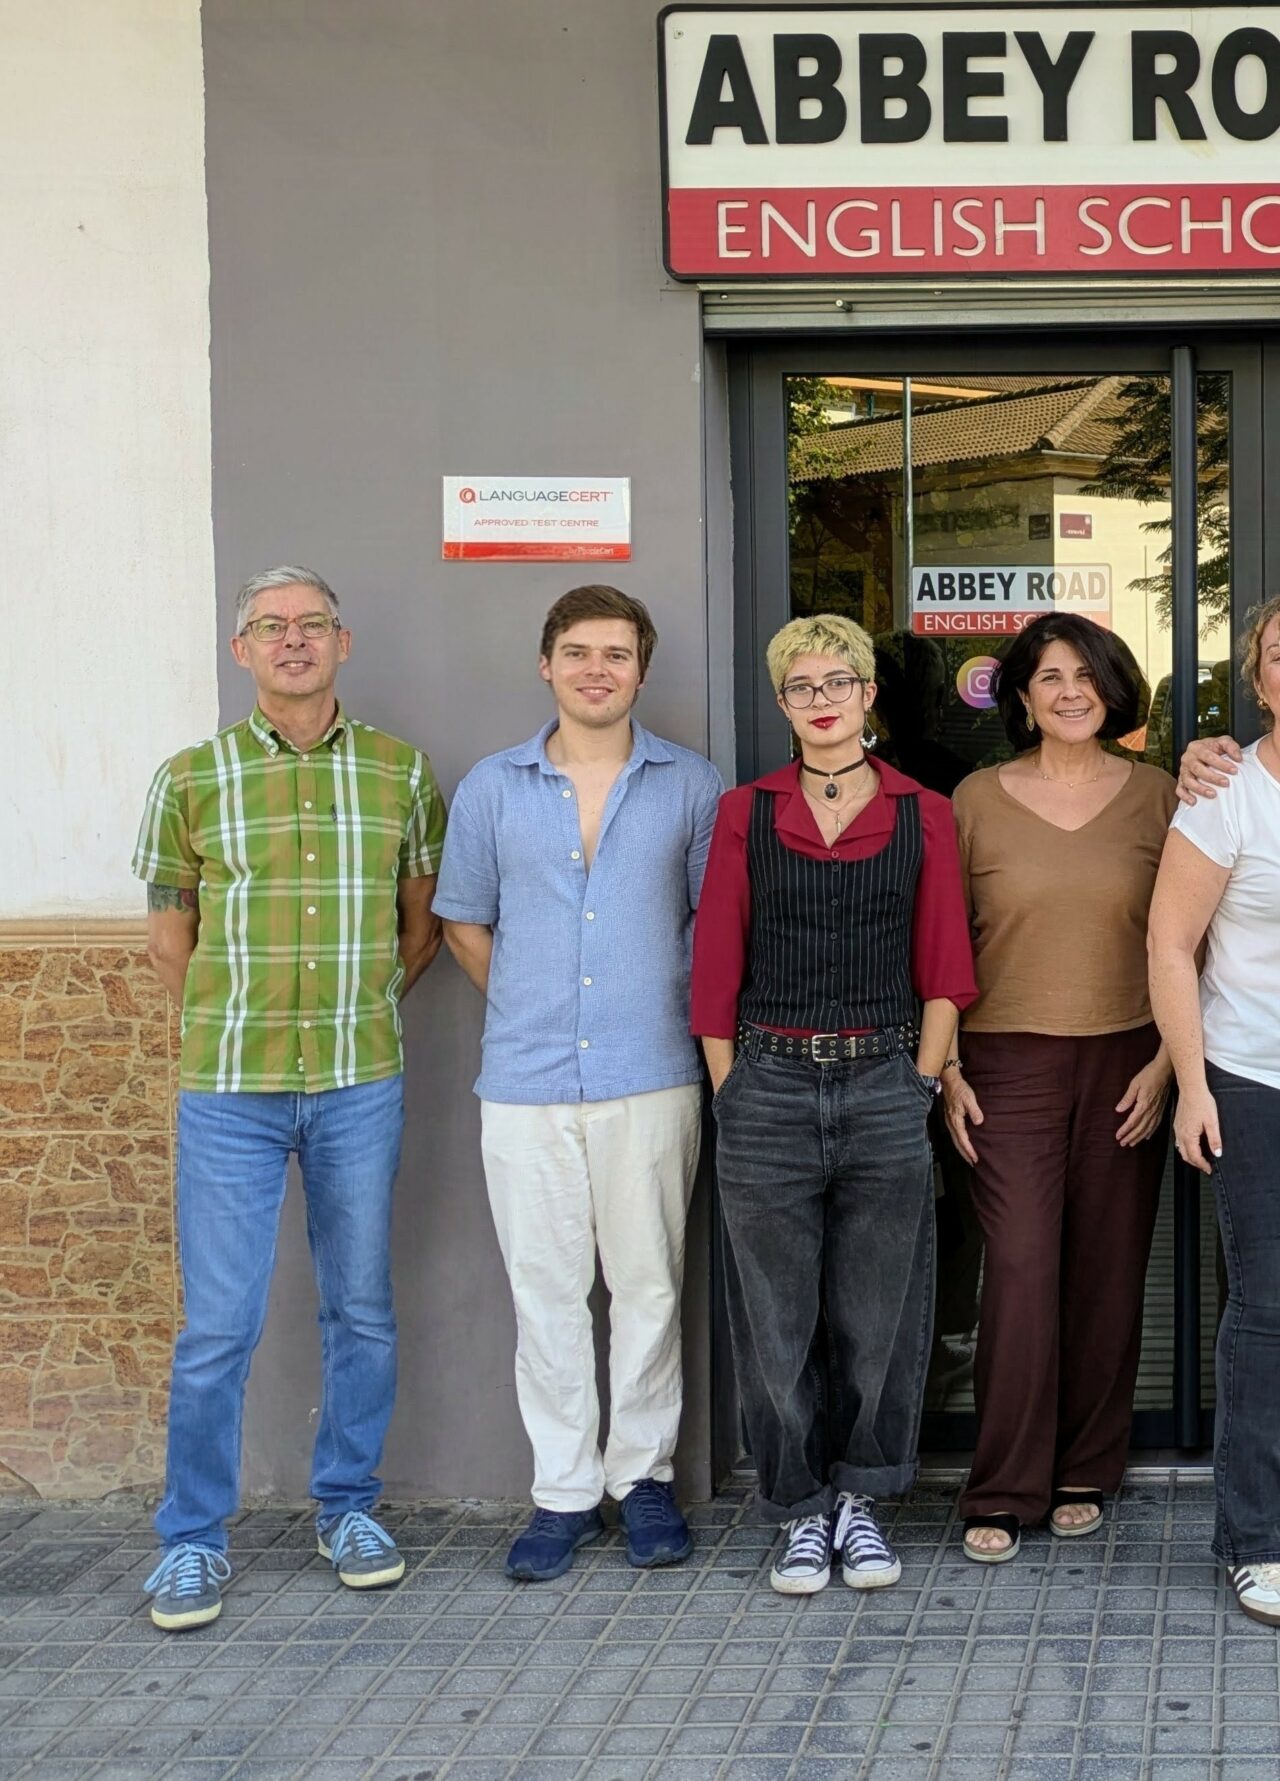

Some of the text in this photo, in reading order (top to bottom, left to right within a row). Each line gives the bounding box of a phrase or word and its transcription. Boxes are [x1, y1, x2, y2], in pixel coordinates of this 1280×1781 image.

[685, 30, 1096, 146] ABBEY
[717, 195, 1047, 260] ENGLISH
[479, 489, 611, 503] LANGUAGECERT
[474, 519, 600, 528] APPROVED TEST CENTRE
[916, 571, 1106, 602] ABBEY ROAD
[923, 613, 1007, 631] ENGLISH
